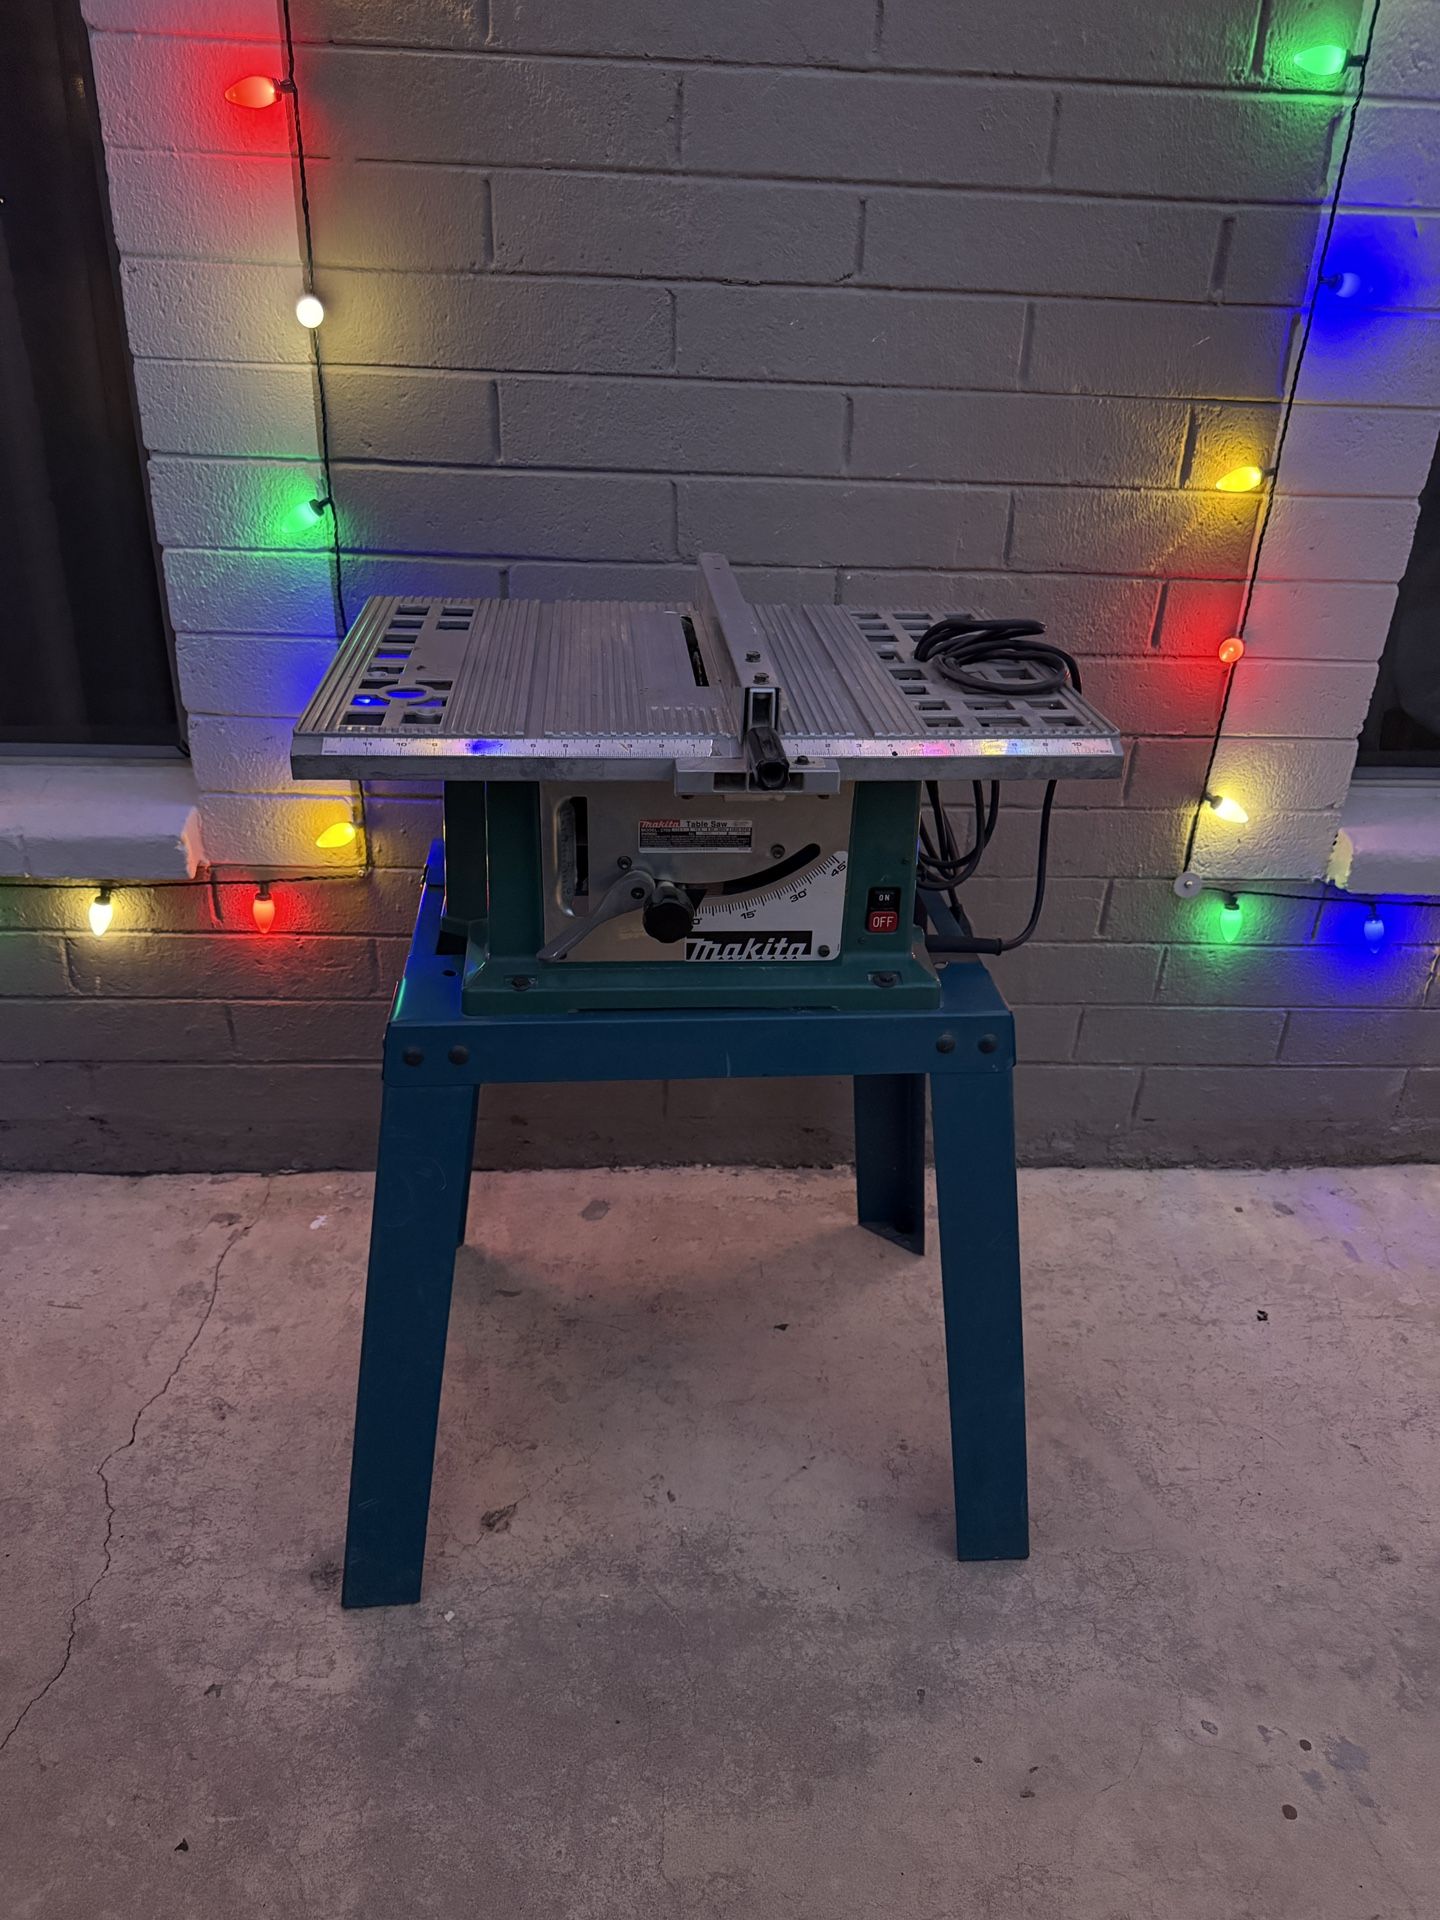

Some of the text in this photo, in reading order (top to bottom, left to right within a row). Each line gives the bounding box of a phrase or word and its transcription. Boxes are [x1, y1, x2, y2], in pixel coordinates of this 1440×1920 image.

[687, 820, 708, 828] Table
[711, 820, 728, 828] Saw
[879, 894, 890, 902] ON
[873, 916, 895, 928] OFF
